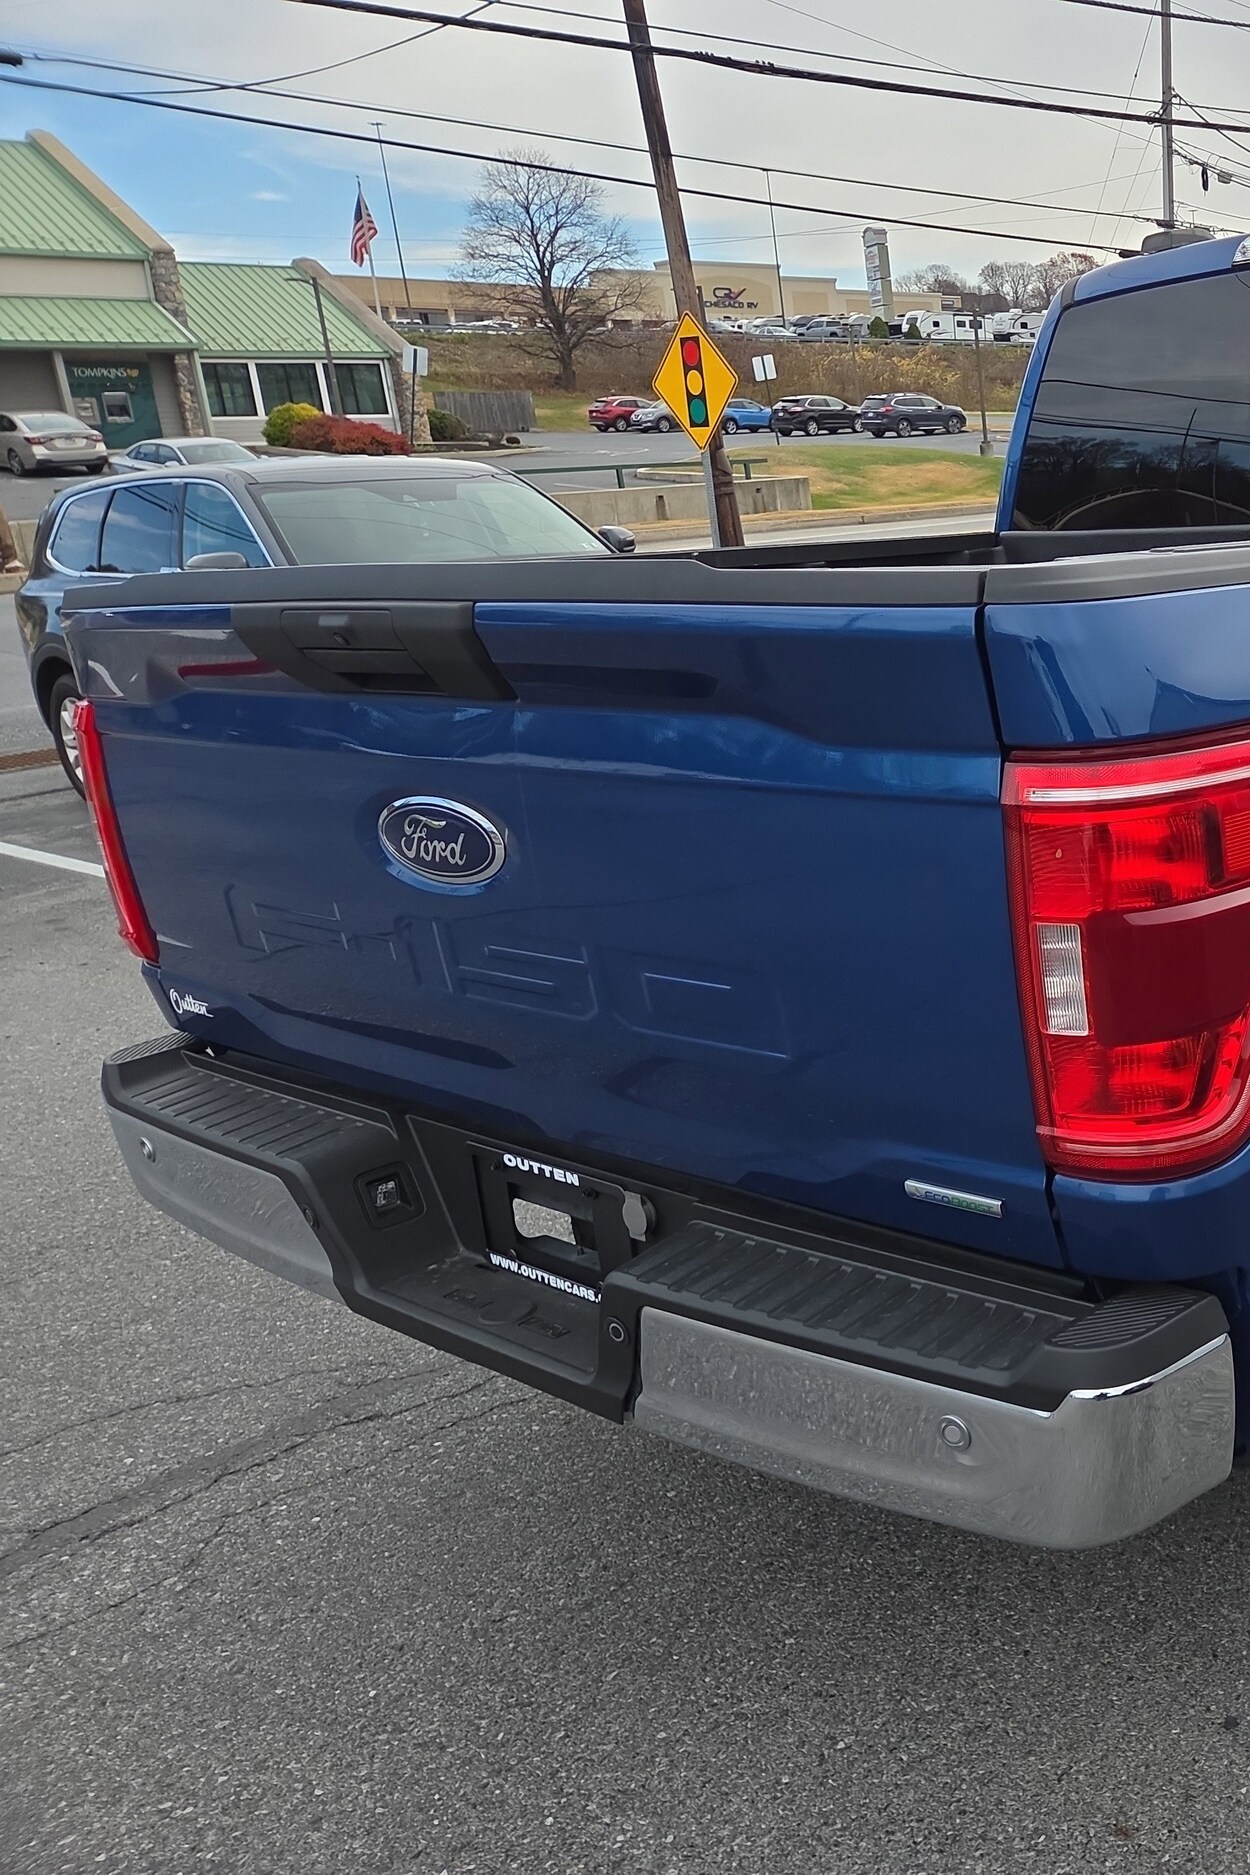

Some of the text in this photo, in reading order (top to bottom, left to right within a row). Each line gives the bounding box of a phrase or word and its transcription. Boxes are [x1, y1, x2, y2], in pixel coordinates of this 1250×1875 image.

[73, 367, 127, 379] TOMPKINS
[401, 814, 467, 866] Ford
[170, 988, 214, 1018] Outten
[503, 1153, 580, 1187] OUTTEN
